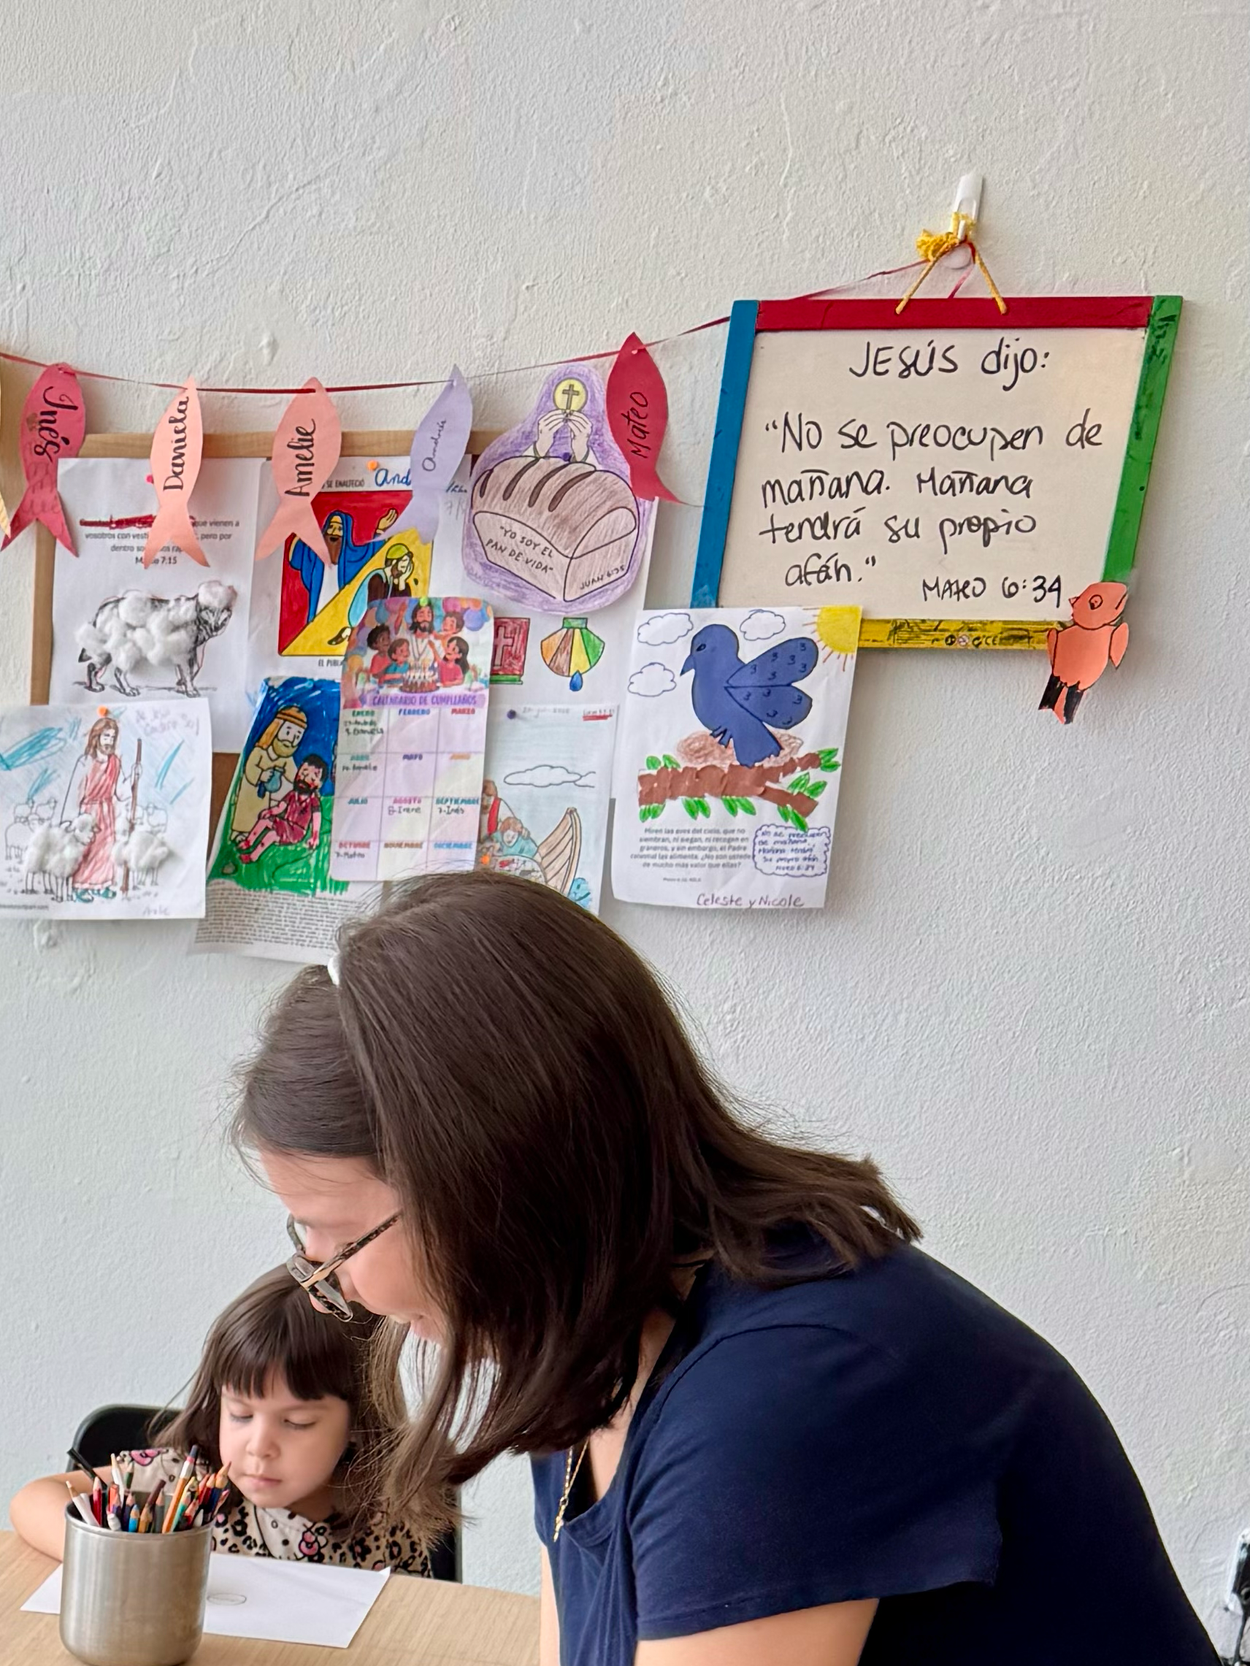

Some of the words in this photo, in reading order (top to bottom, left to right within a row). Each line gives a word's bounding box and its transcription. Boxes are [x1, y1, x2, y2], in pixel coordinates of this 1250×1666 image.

[849, 338, 959, 379] JESÚS
[980, 336, 1051, 391] dijo:
[33, 386, 79, 463] Inés
[163, 396, 190, 491] Daniela
[621, 391, 651, 459] Mateo
[839, 419, 878, 450] se
[886, 422, 1044, 464] preocupen
[1064, 408, 1103, 449] de
[285, 418, 317, 497] Amelie
[760, 468, 891, 508] mañana.
[916, 467, 1034, 499] Mañana
[485, 538, 507, 554] PAN
[508, 550, 521, 562] DE
[520, 536, 540, 551] SOY
[541, 547, 553, 558] EL
[758, 507, 868, 546] tendrá
[884, 513, 921, 543] su
[938, 512, 1037, 554] propio
[1001, 575, 1062, 609] 6:34
[419, 695, 430, 705] DE
[696, 893, 743, 907] Celeste
[749, 899, 756, 908] y
[758, 894, 805, 907] Nicole
